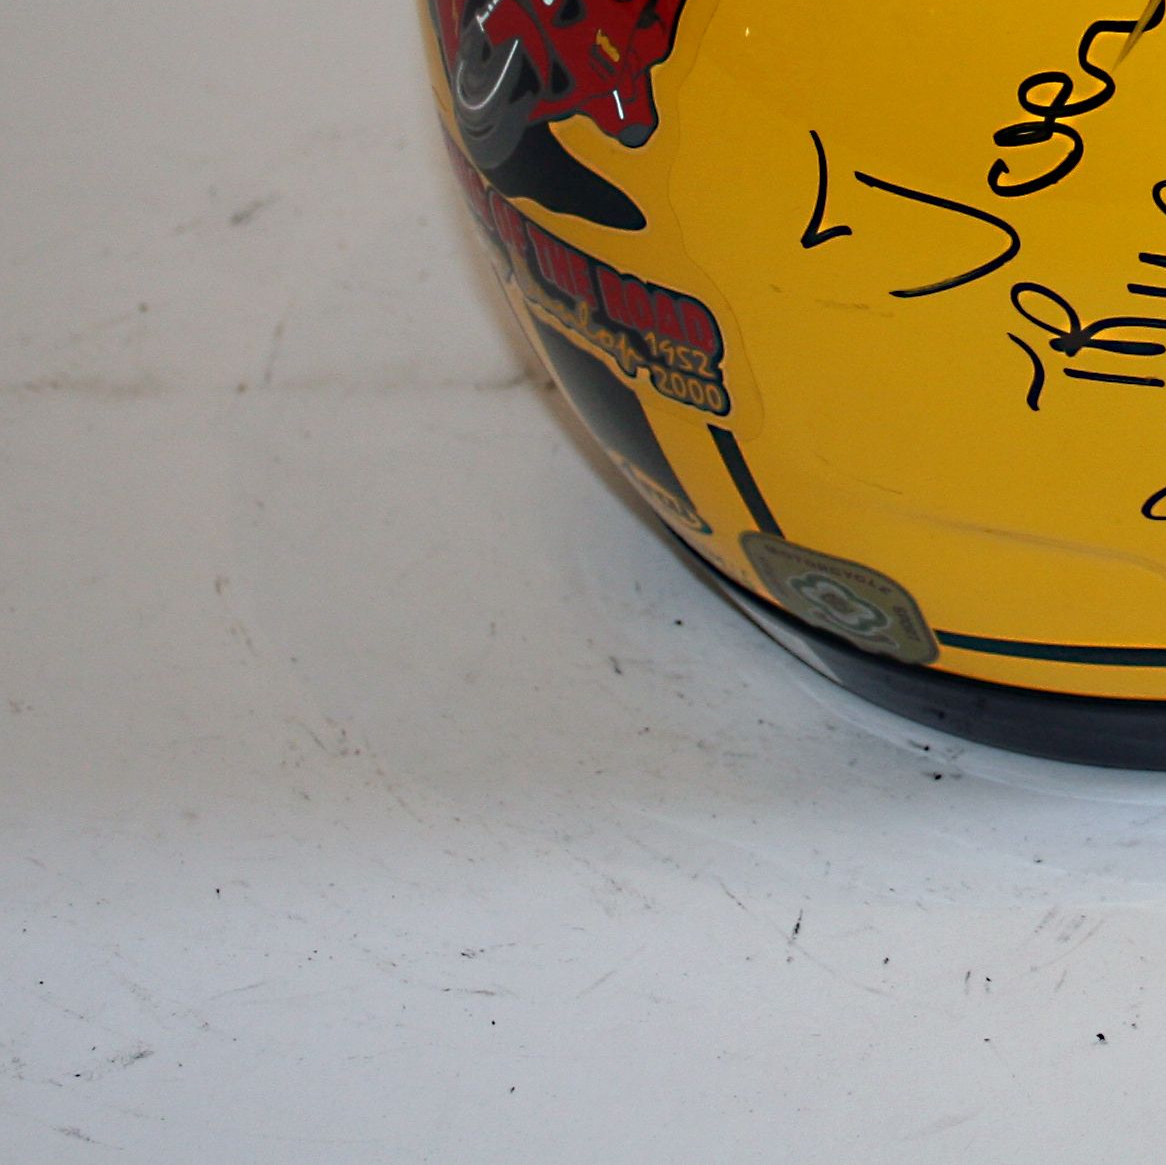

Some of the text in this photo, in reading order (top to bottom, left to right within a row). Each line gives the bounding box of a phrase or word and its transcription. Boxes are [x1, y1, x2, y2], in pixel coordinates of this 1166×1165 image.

[526, 221, 597, 311] THE
[597, 265, 716, 355] ROAD
[645, 332, 715, 378] 1952
[652, 366, 725, 412] 2000
